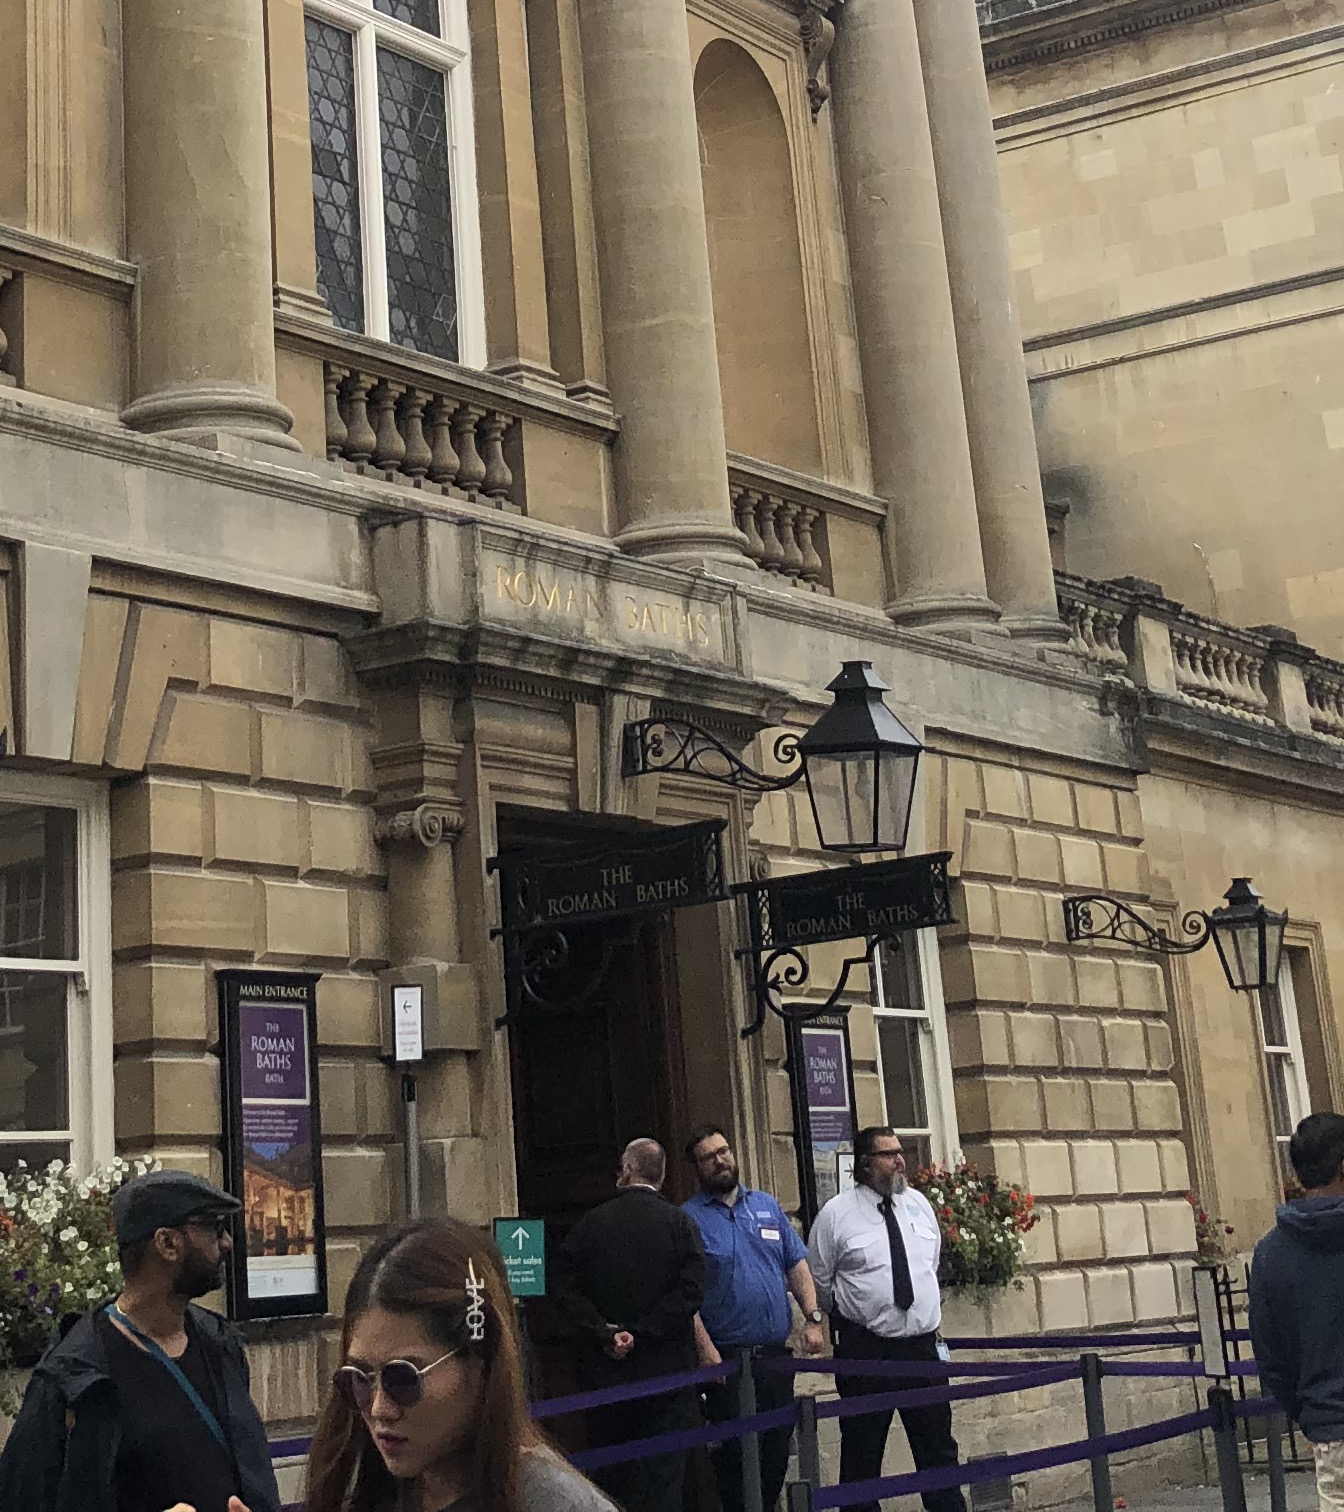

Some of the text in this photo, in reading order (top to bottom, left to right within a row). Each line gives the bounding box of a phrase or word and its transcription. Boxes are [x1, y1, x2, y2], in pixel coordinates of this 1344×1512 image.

[496, 565, 709, 646] ROMAN BATHS
[600, 865, 633, 886] THE
[547, 877, 689, 917] ROMAN BATHS
[835, 892, 866, 912] THE
[786, 903, 918, 938] ROMAN BATHS
[239, 984, 308, 999] MAIN ENTRANCE
[265, 1022, 280, 1033] THE
[251, 1036, 295, 1052] ROMAN
[256, 1052, 291, 1069] BATHS
[809, 1056, 837, 1070] ROMAN
[265, 1073, 284, 1084] BATH
